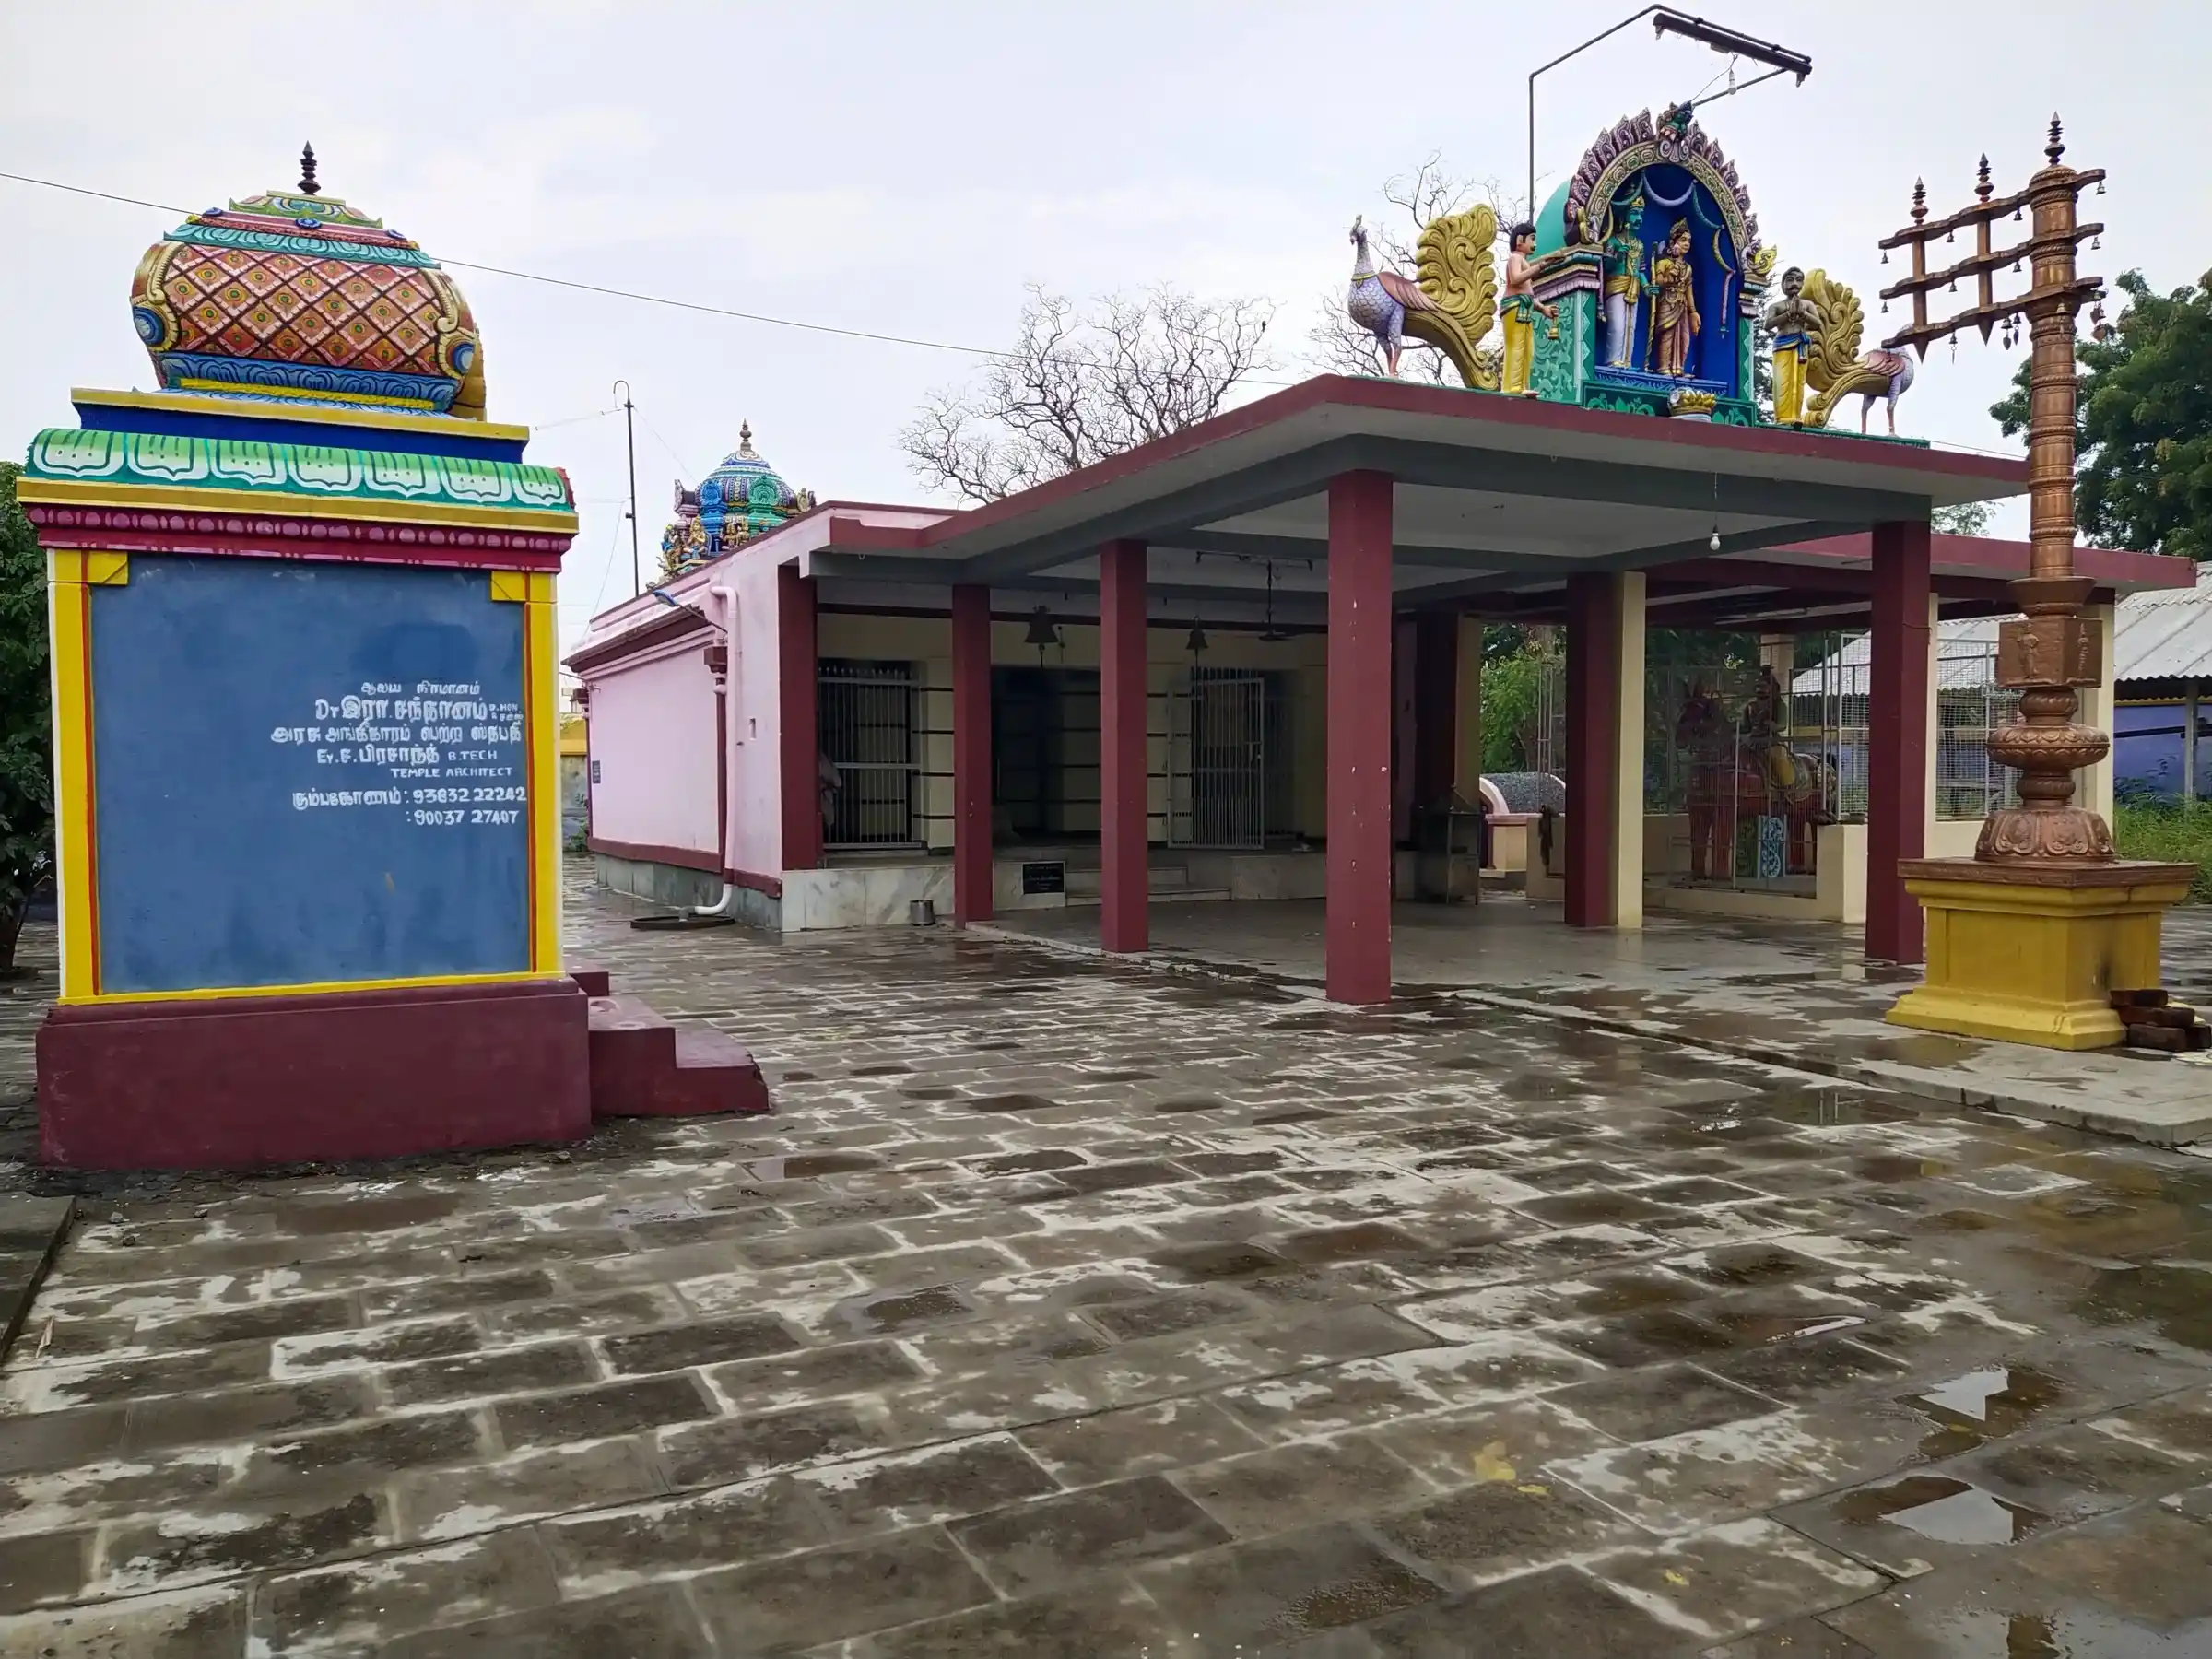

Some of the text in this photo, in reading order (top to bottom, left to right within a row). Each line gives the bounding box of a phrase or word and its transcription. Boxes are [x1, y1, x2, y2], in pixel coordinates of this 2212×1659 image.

[360, 682, 402, 695] ஆலய
[390, 767, 513, 778] TEMPLE ARCHITECT
[473, 786, 527, 802] 22242
[471, 809, 520, 825] 27407
